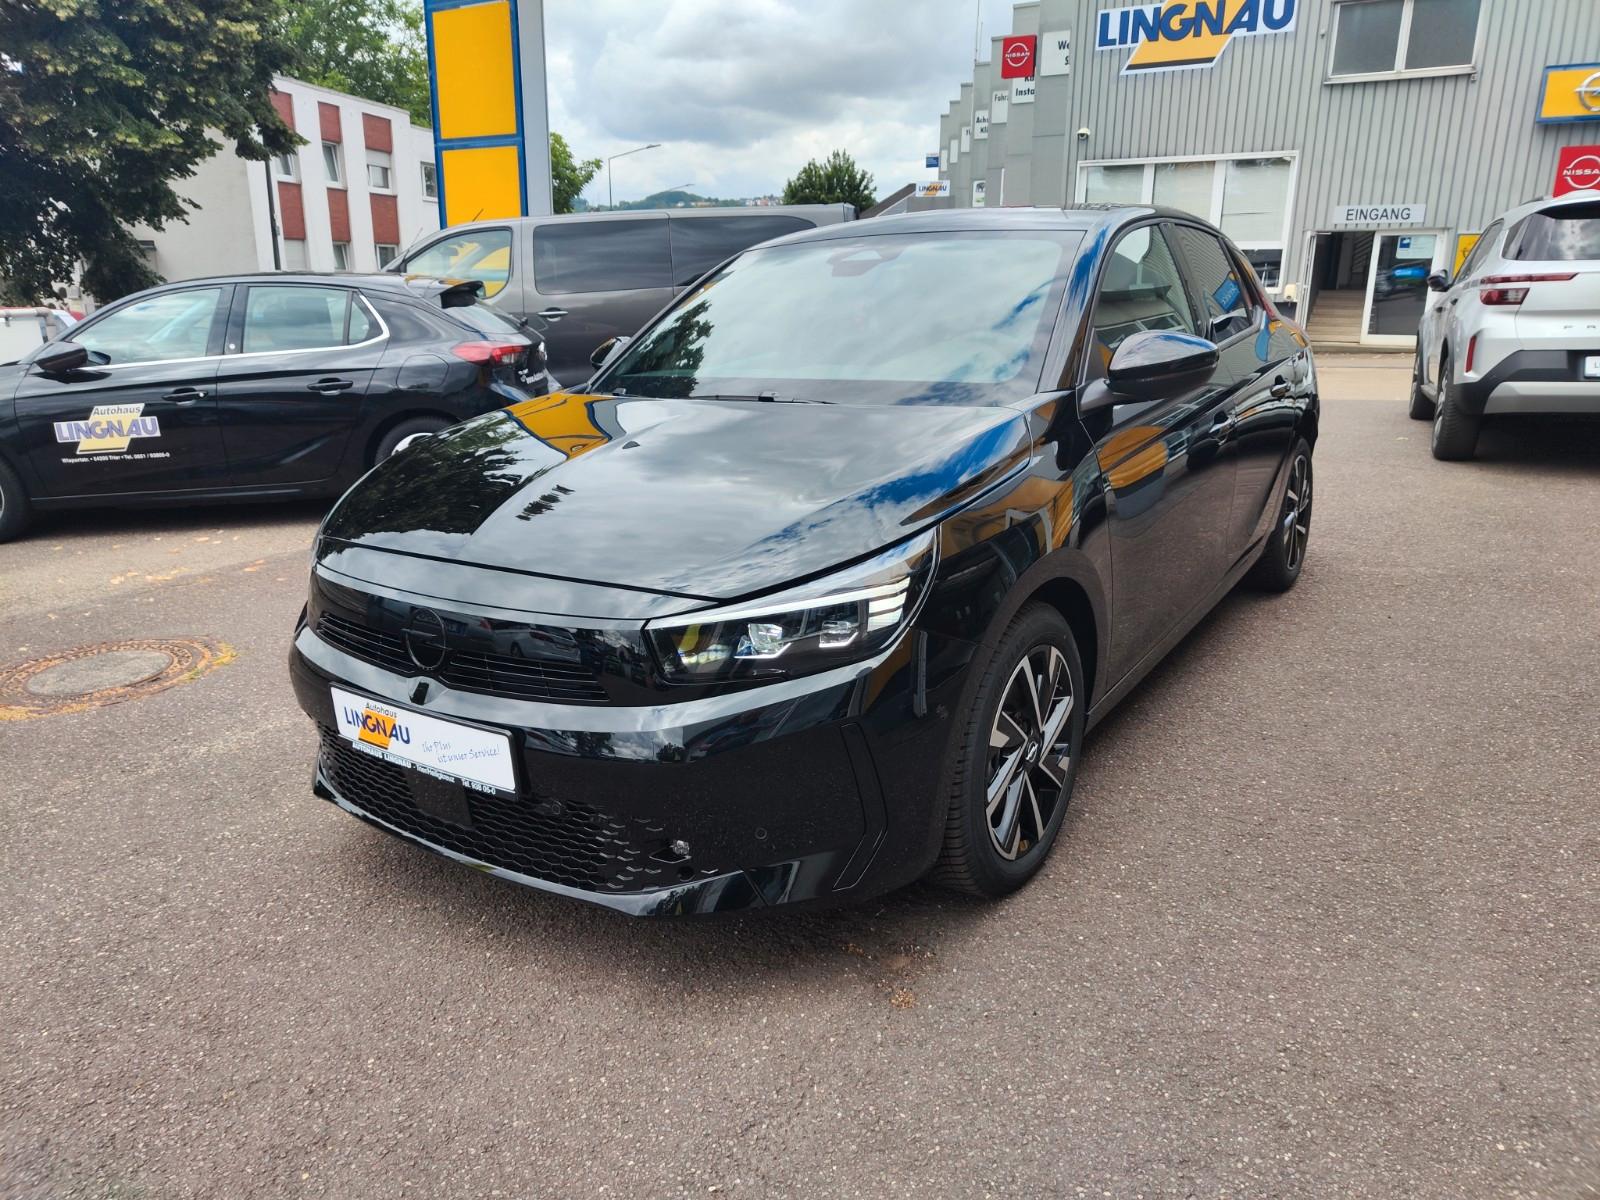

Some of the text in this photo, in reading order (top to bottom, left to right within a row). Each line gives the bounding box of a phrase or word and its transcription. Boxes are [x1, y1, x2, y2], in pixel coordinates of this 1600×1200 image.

[1098, 0, 1295, 47] LINGNAU
[918, 185, 947, 193] LINGNAU
[1345, 207, 1411, 221] EINGANG
[93, 405, 141, 416] Autohaus
[55, 418, 158, 441] LINGNAU
[365, 702, 397, 719] Autohaus
[344, 706, 411, 745] LINGNAU
